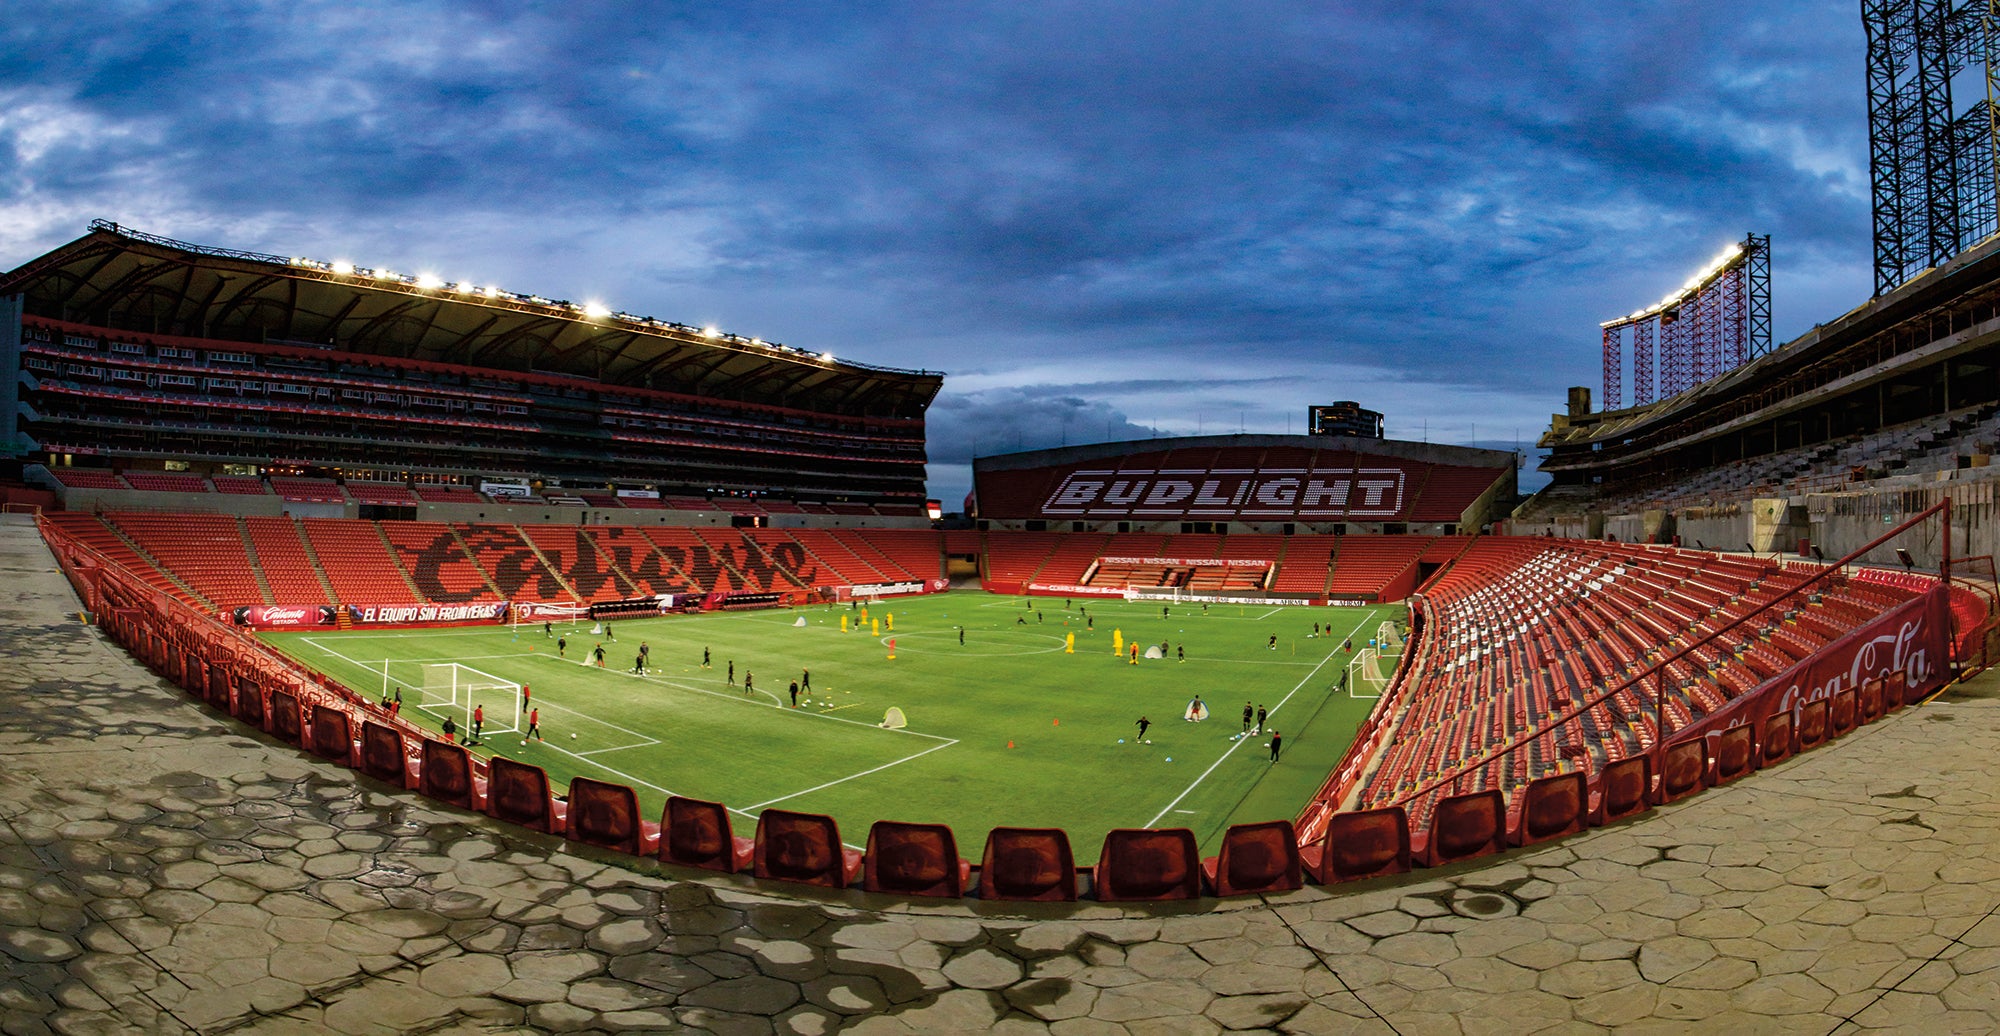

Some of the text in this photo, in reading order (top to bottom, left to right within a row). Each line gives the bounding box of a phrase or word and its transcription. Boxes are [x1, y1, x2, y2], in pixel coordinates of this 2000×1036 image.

[1227, 559, 1266, 567] NISSAN
[262, 606, 306, 621] Caliente
[362, 604, 497, 622] EL EQUIPO SIN FRONTERAS
